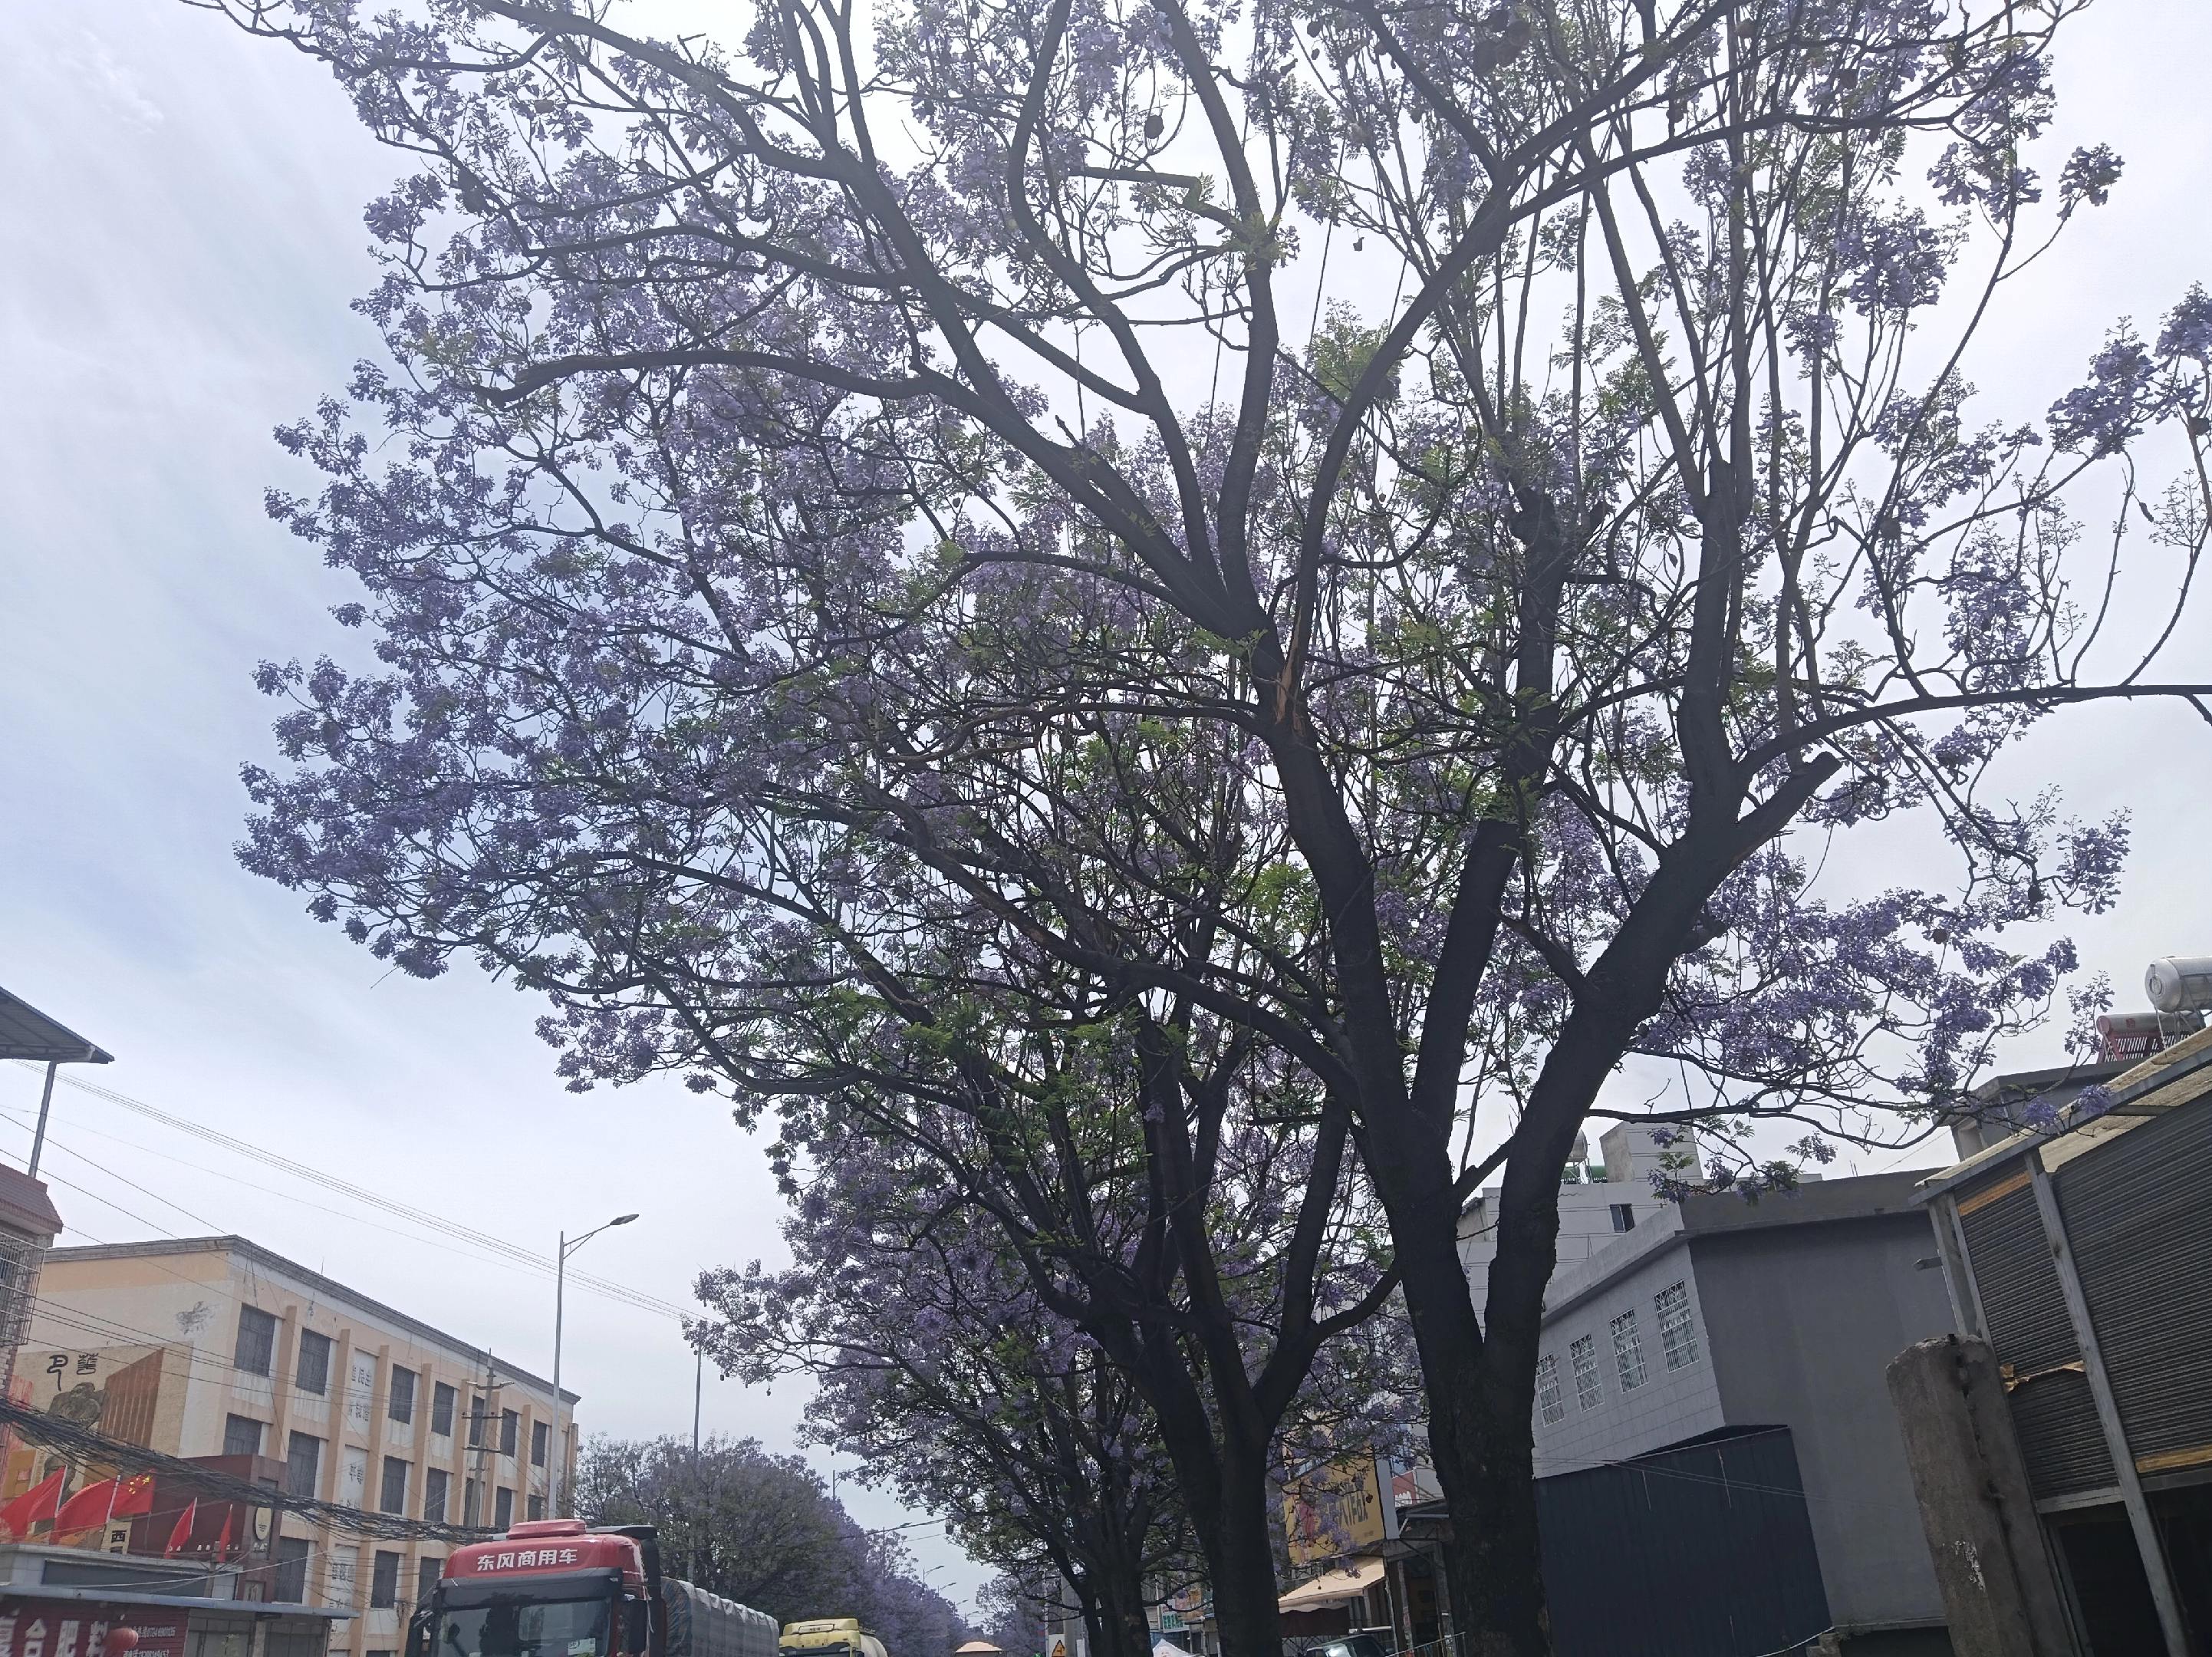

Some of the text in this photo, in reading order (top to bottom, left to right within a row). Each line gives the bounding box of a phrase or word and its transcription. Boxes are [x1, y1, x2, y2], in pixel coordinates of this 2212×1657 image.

[477, 1549, 578, 1571] 东风商用车
